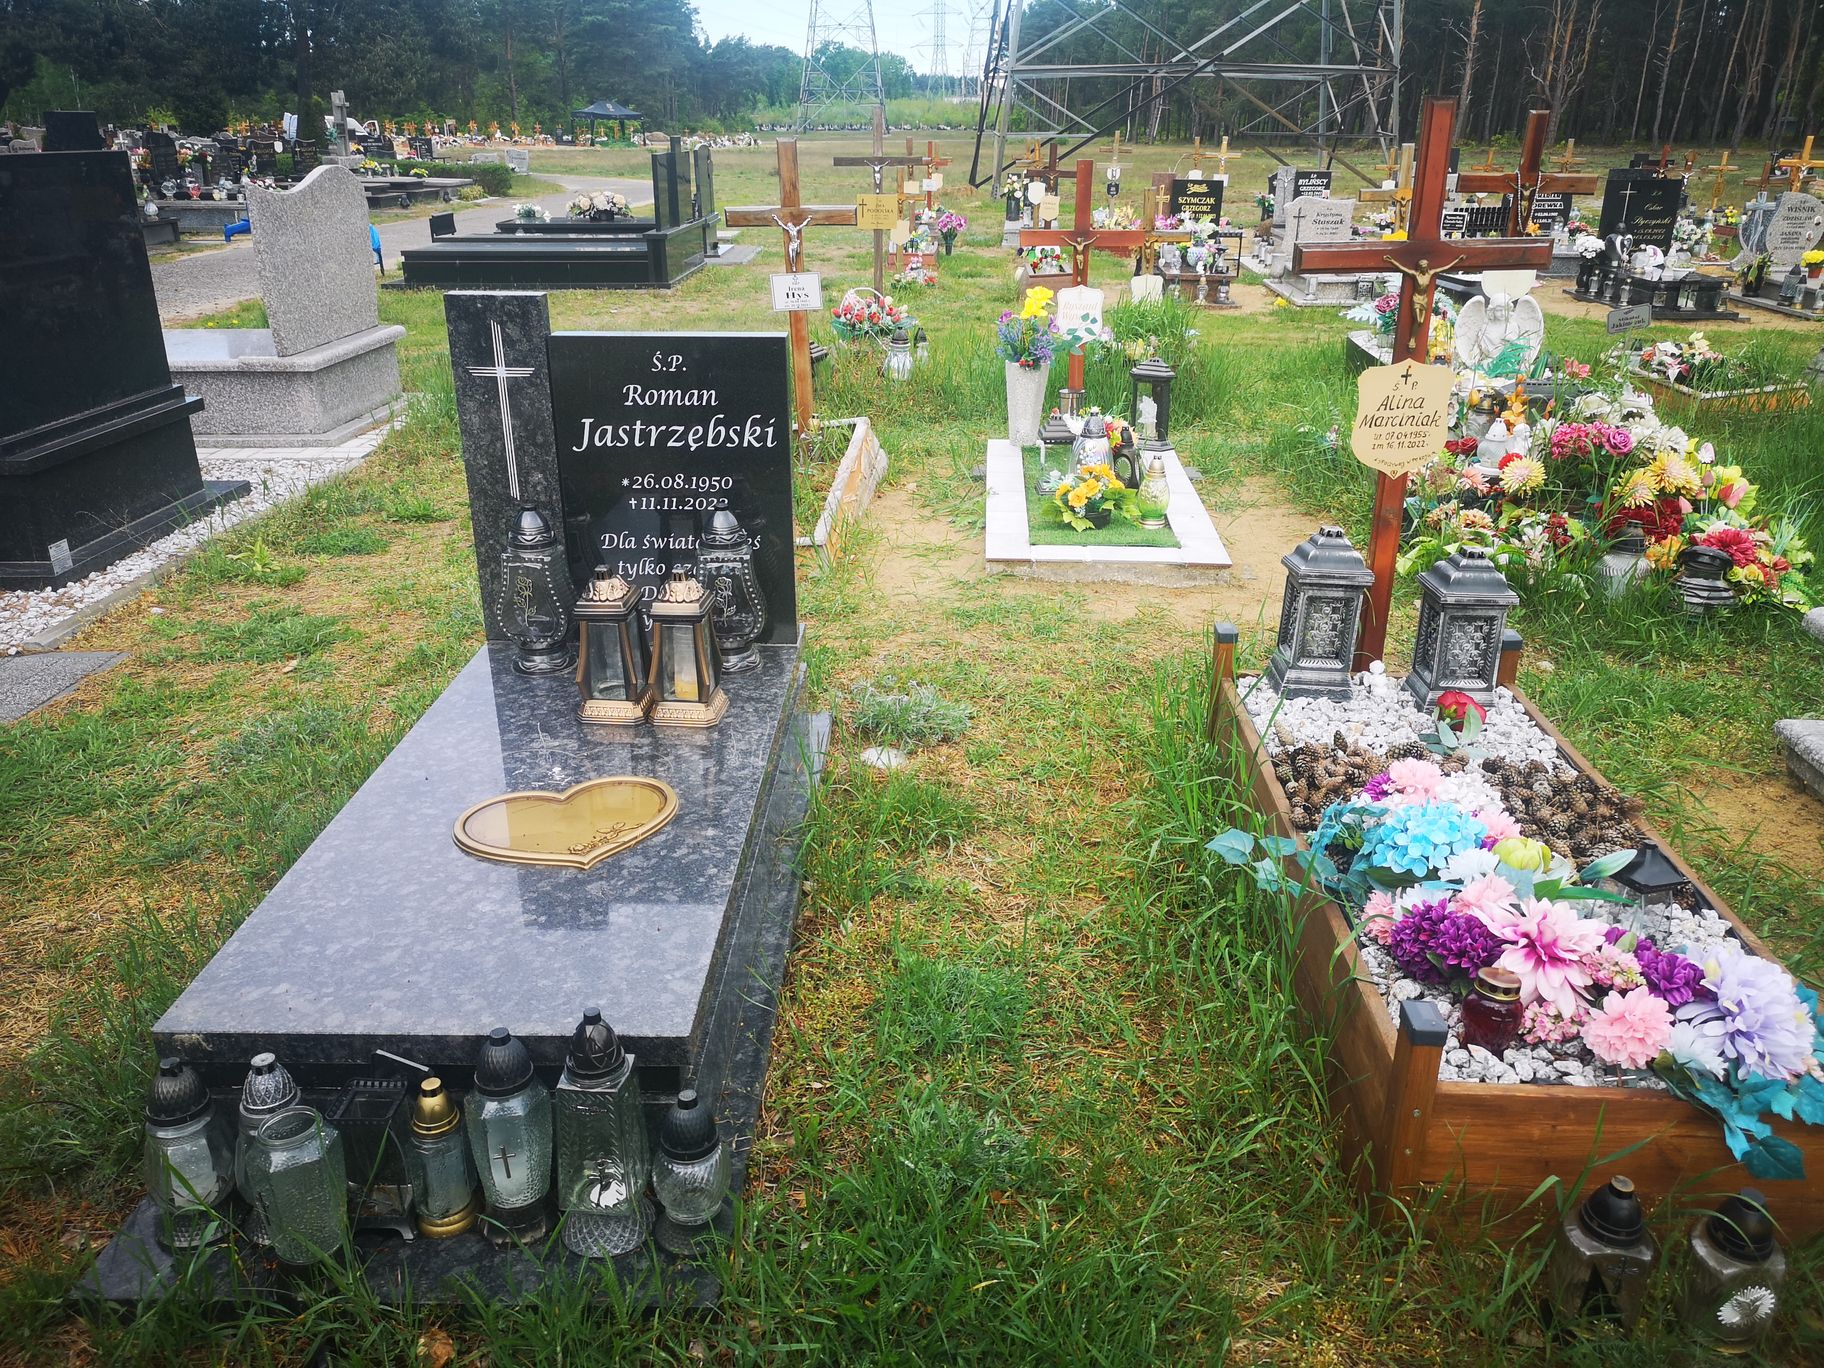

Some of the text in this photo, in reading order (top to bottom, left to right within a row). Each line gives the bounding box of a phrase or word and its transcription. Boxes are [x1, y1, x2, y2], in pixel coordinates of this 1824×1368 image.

[1178, 196, 1216, 204] SZYMCZAK
[651, 351, 688, 372] Ś.P.
[622, 384, 719, 406] Roman
[1376, 394, 1426, 412] Alina
[1359, 410, 1442, 429] Marciniak
[572, 414, 778, 452] Jastrzębski
[600, 531, 638, 550] Dla
[618, 558, 666, 580] tylko
